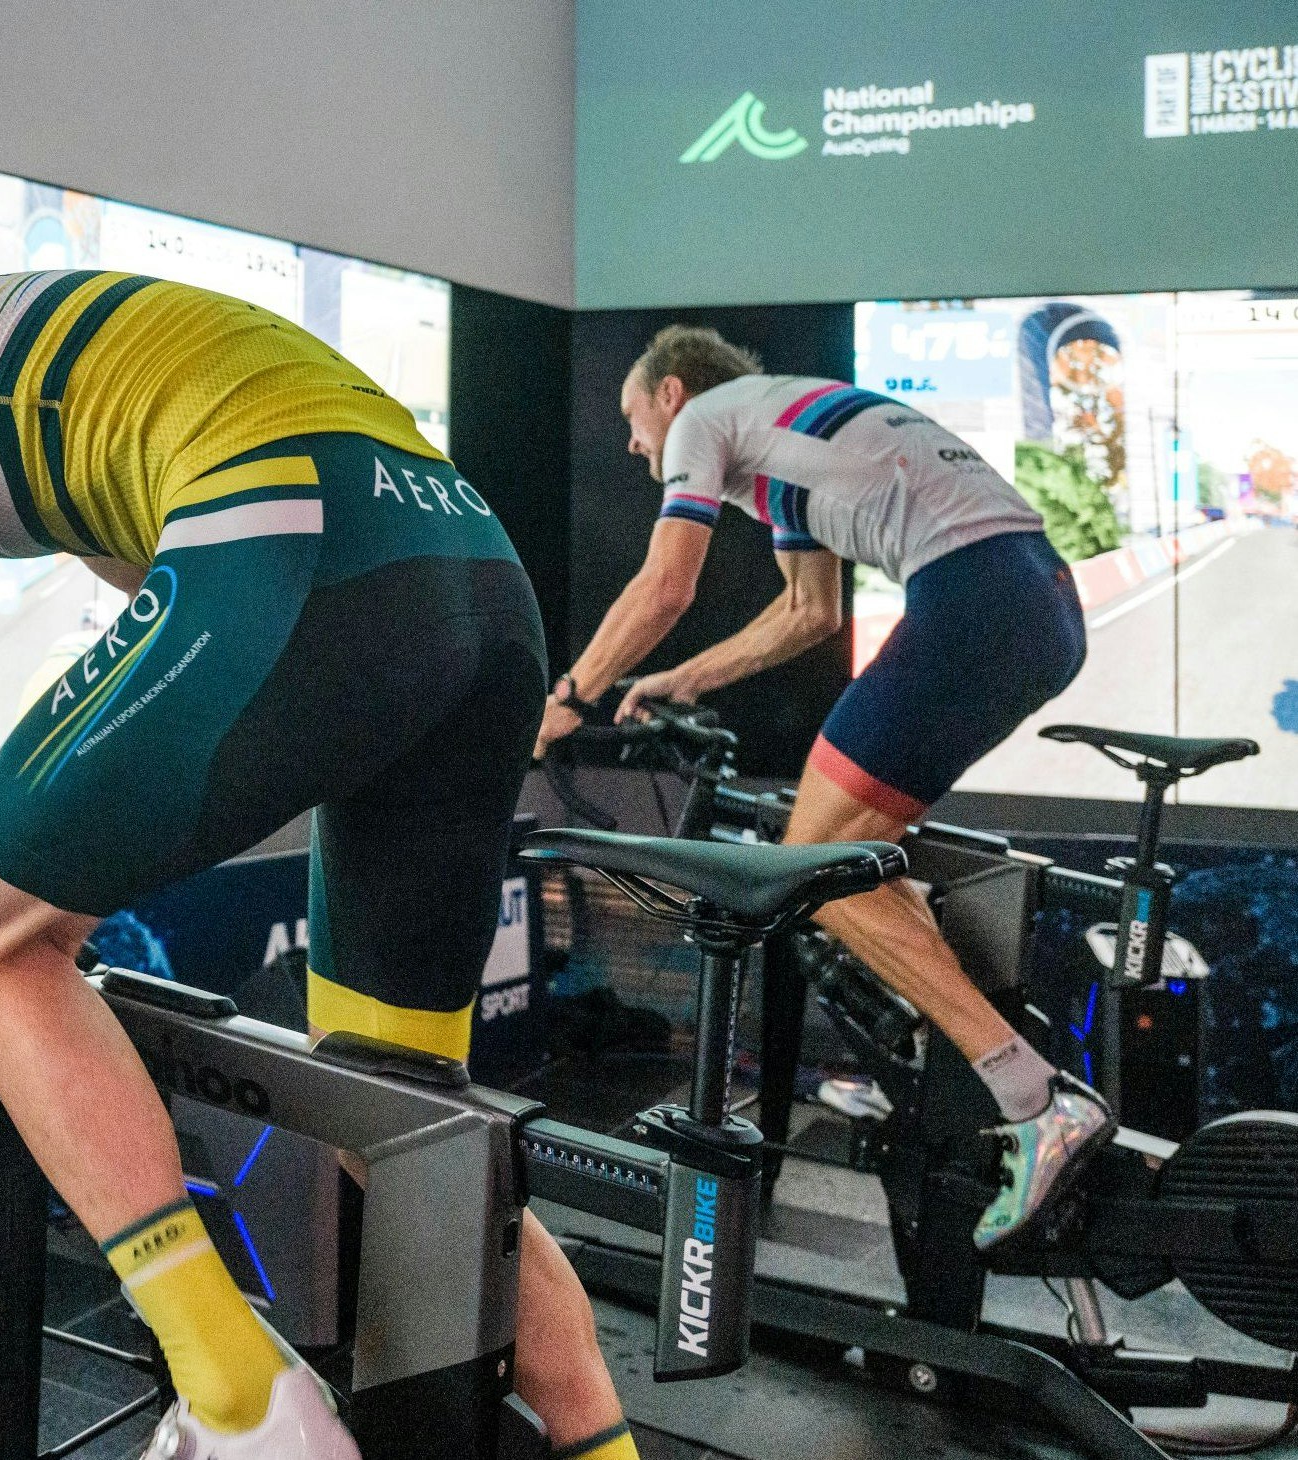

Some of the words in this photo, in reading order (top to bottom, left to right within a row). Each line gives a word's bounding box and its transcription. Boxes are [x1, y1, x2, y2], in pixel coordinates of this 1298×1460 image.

[822, 99, 1036, 136] Championships
[823, 79, 935, 112] National
[373, 456, 491, 517] AERO
[51, 588, 160, 716] AERO
[76, 723, 115, 757] AUSTRALIAN
[140, 680, 167, 705] RACING
[164, 630, 212, 683] ORGANISATION
[499, 888, 524, 926] UT
[1124, 919, 1149, 980] KICKR
[480, 983, 530, 1022] SPORT
[693, 1176, 718, 1244] BIKE
[677, 1237, 714, 1357] KICKR
